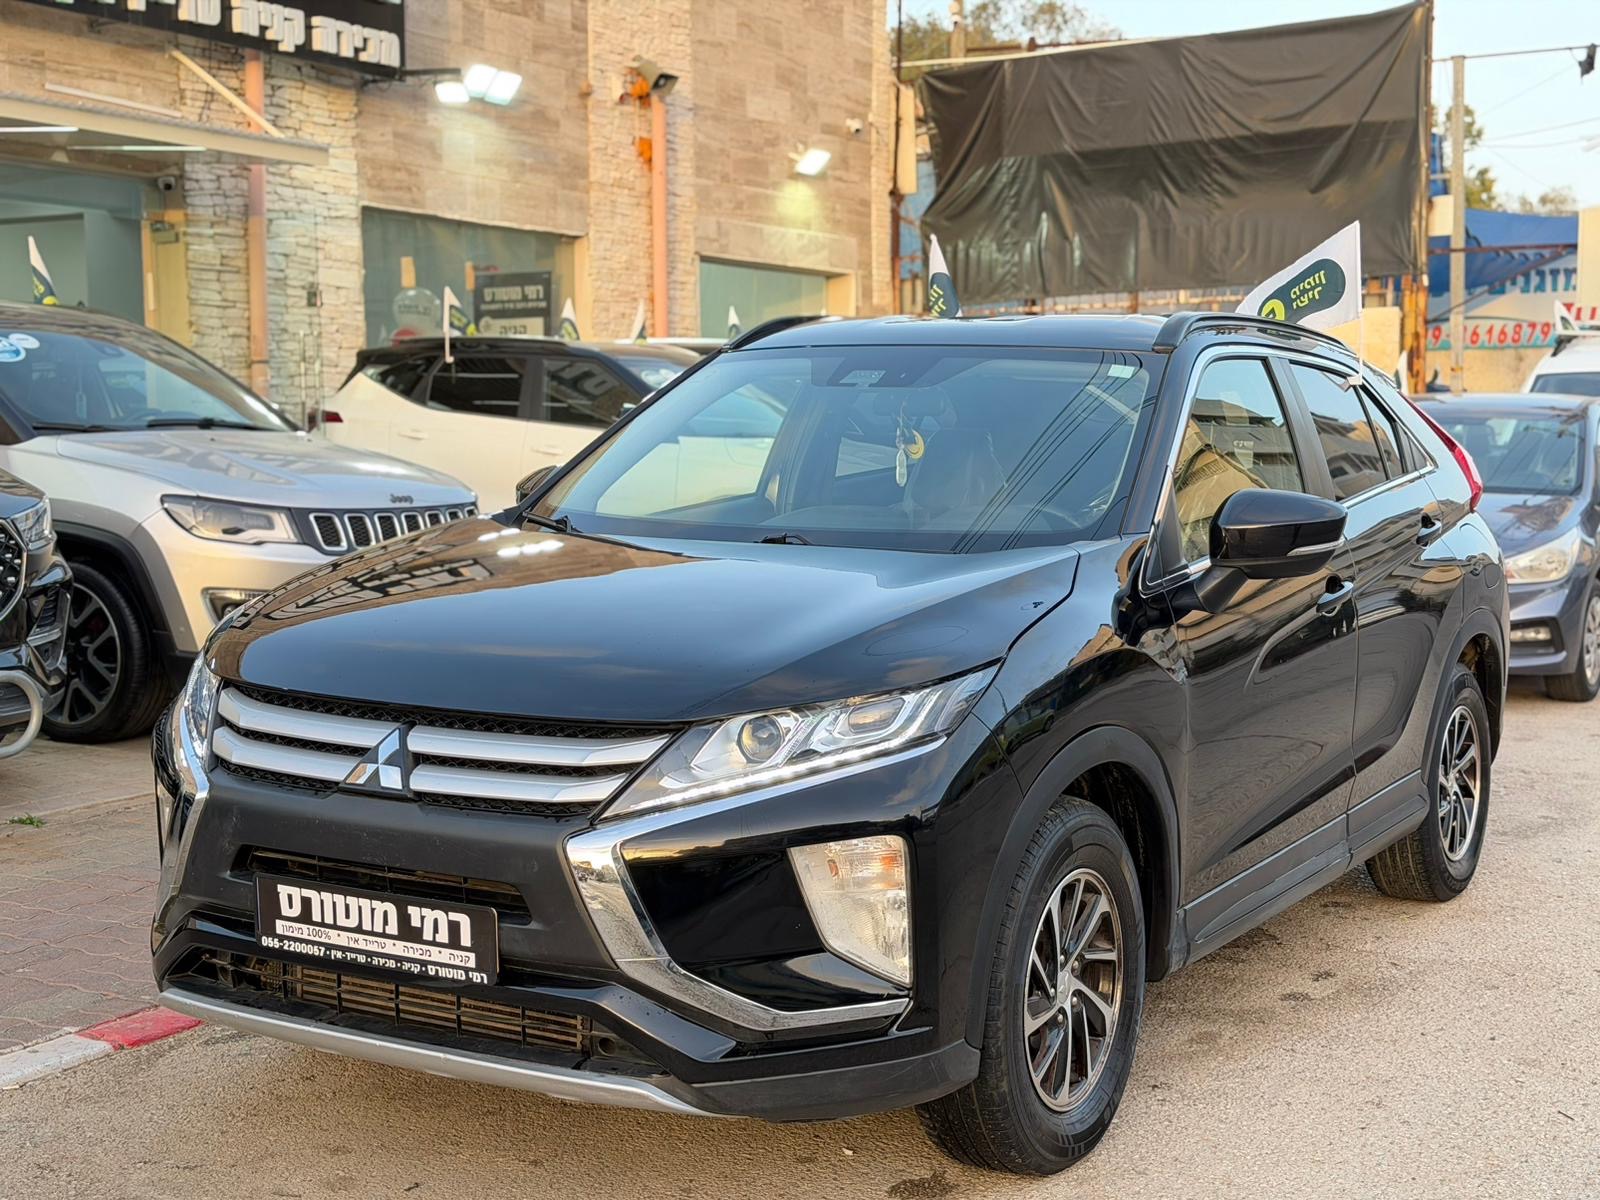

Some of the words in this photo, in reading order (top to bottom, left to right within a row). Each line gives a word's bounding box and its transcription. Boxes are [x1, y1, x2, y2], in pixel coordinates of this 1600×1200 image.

[231, 0, 305, 53] קניה
[311, 15, 400, 68] מכירה
[277, 884, 399, 936] מוטורס
[281, 923, 304, 936] מימון
[306, 926, 332, 941] 100%
[407, 905, 472, 948] רמי
[261, 935, 326, 957] 055-2200057
[346, 935, 360, 946] אין
[362, 937, 386, 950] טרייד
[402, 944, 432, 958] מכירה
[372, 956, 396, 968] מכירה
[448, 952, 471, 965] קניה
[402, 961, 421, 975] קניה
[426, 964, 466, 981] מוטורס
[468, 971, 488, 985] רמי
